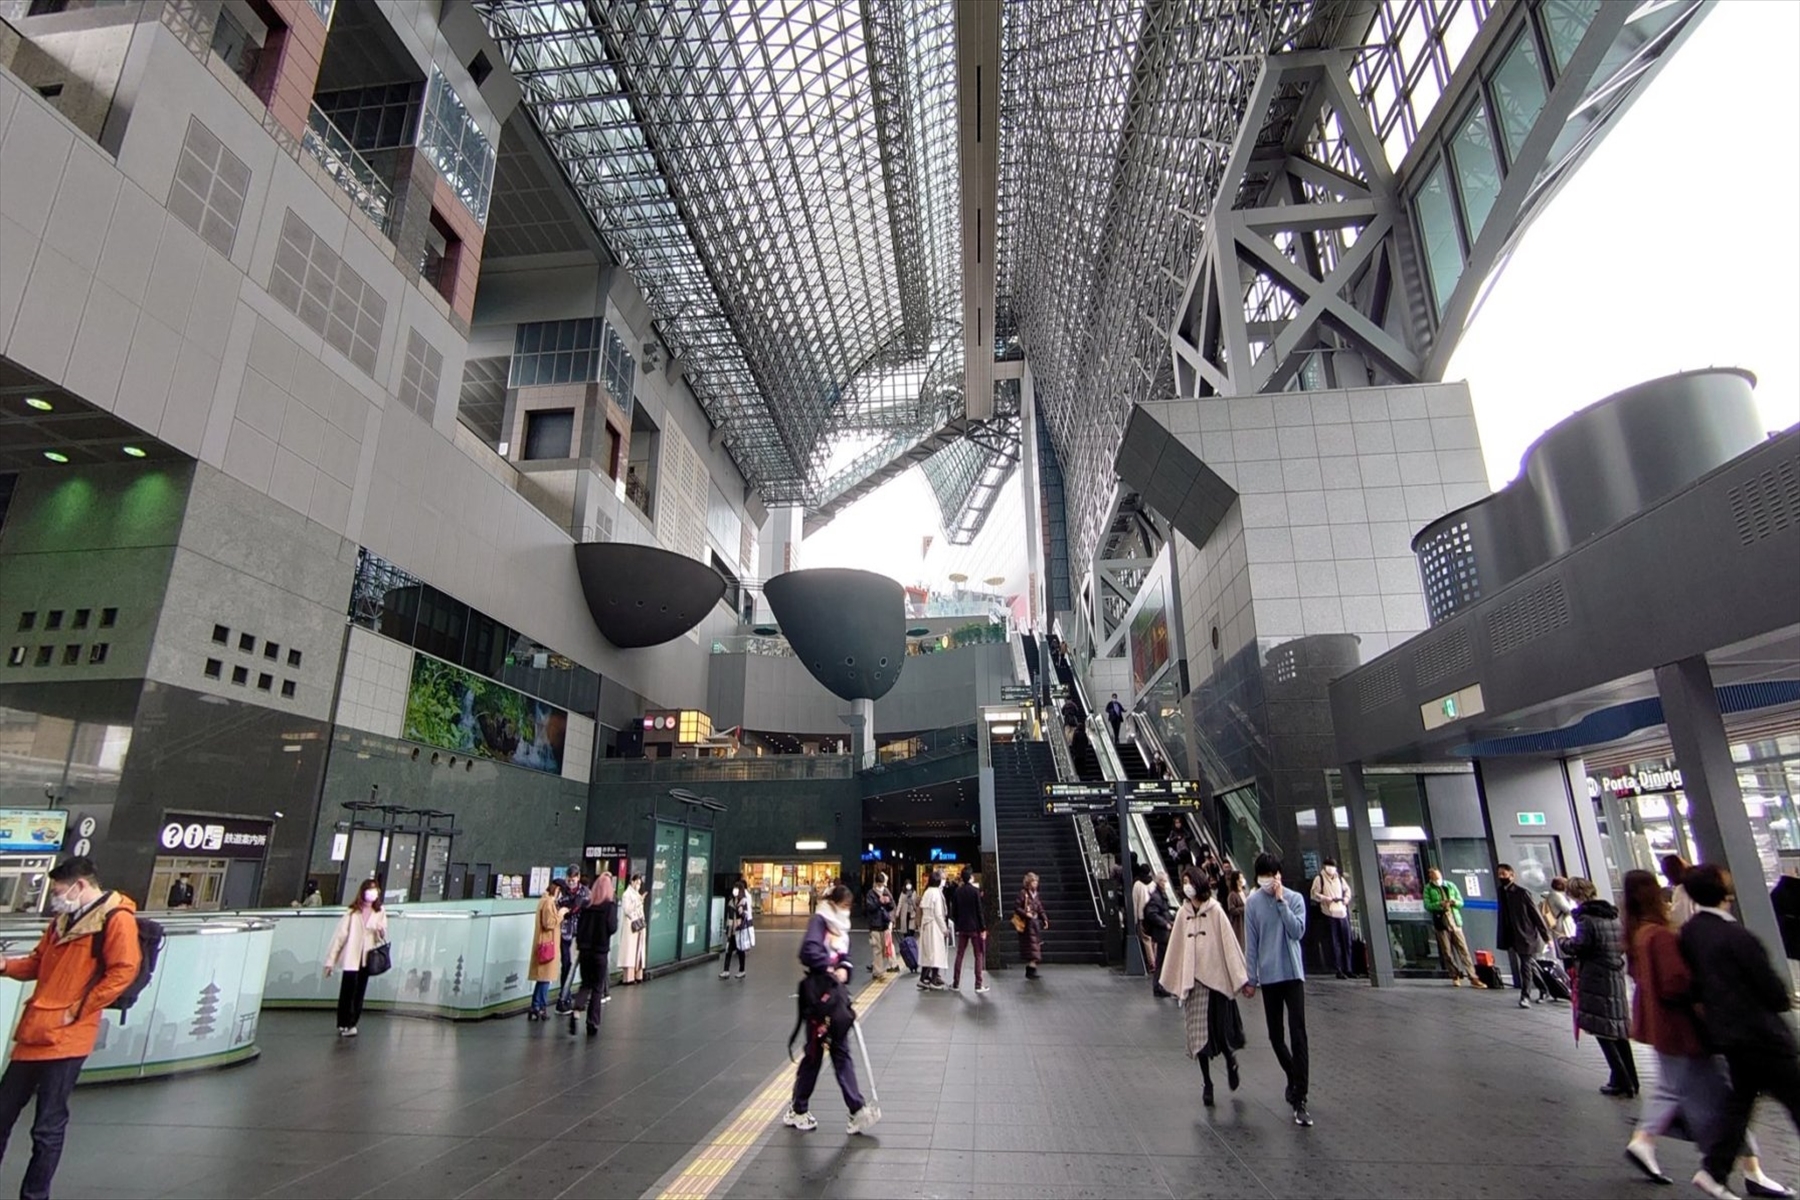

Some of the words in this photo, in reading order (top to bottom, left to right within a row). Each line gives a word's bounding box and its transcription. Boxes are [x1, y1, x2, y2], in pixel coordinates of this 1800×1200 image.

[1602, 775, 1635, 792] Porta
[1639, 768, 1683, 789] Dining
[223, 832, 267, 846] 鉄道案内所
